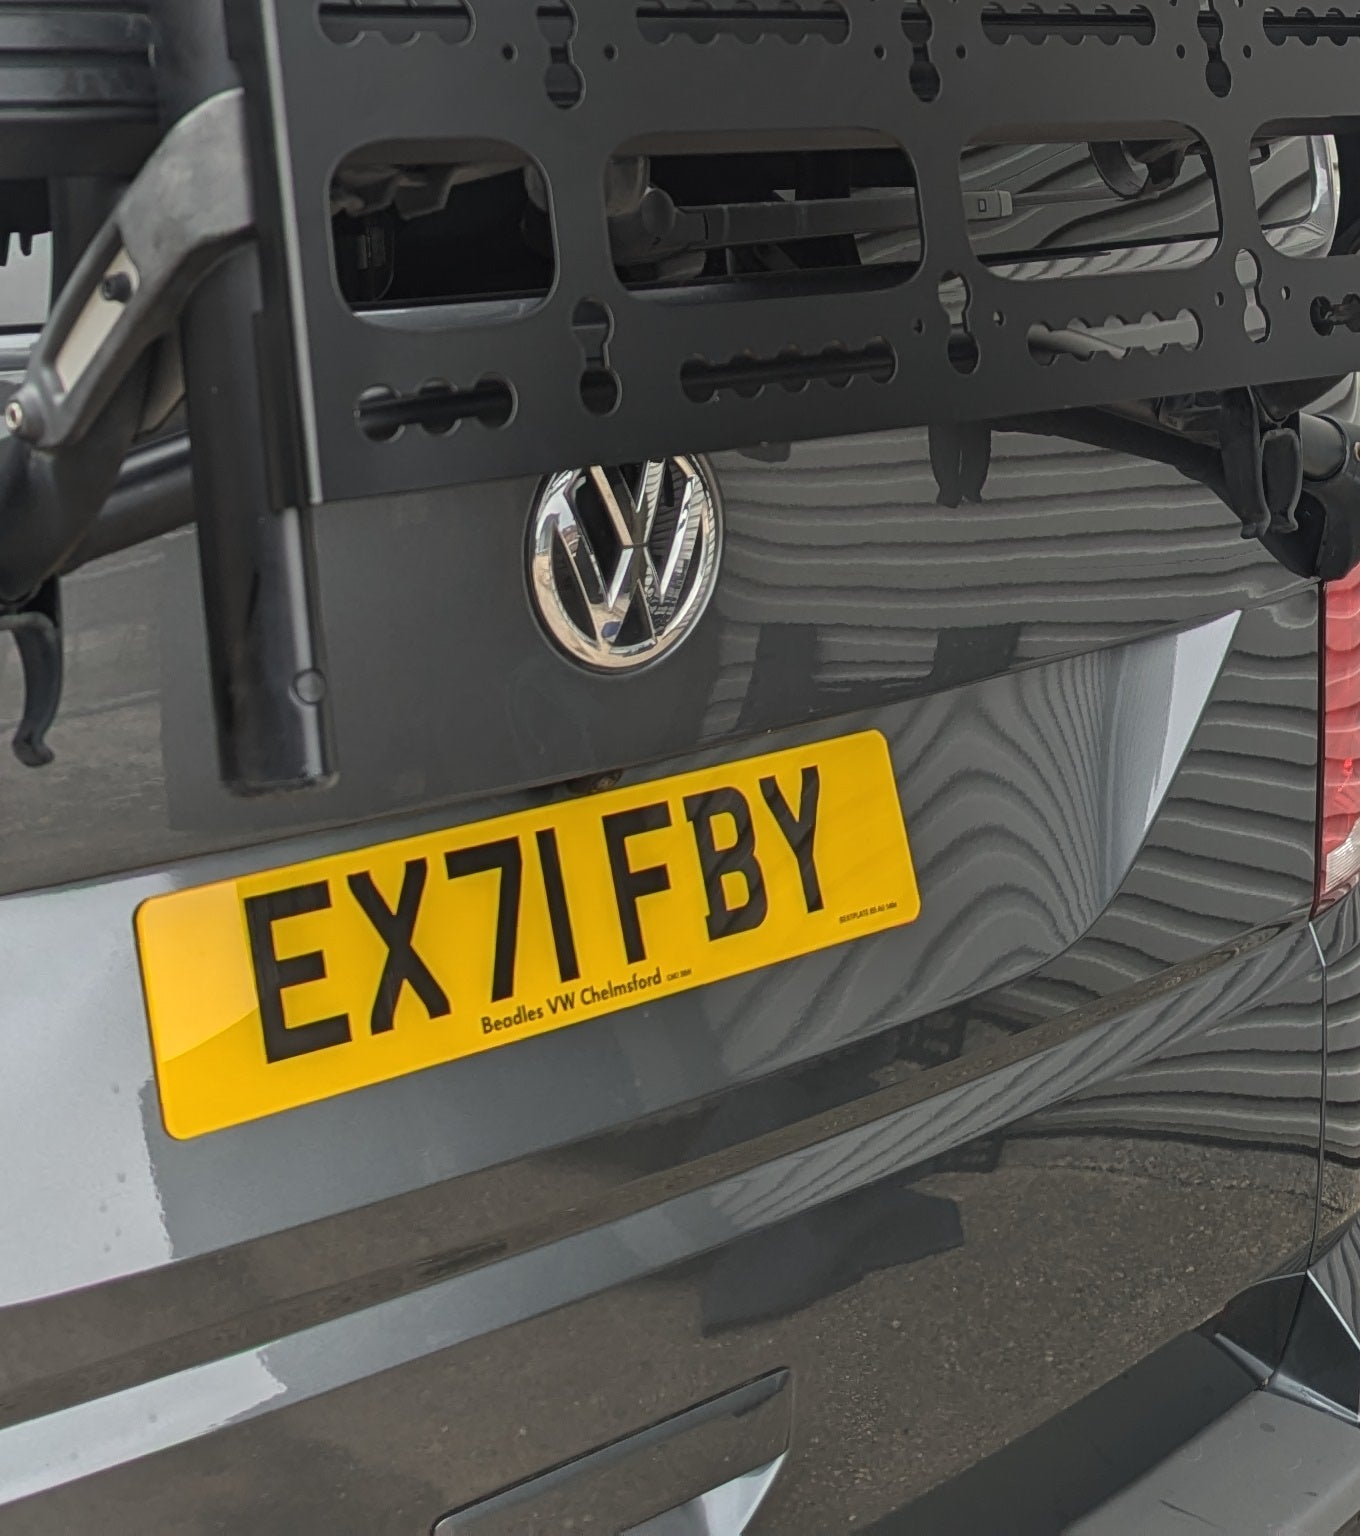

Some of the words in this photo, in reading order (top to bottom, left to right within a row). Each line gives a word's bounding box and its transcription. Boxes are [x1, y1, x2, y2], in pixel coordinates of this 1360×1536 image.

[242, 827, 580, 1064] EX71
[601, 765, 823, 965] FBY
[481, 1005, 544, 1034] Beadles
[546, 992, 576, 1014] VW
[580, 967, 662, 1005] Chelmsford
